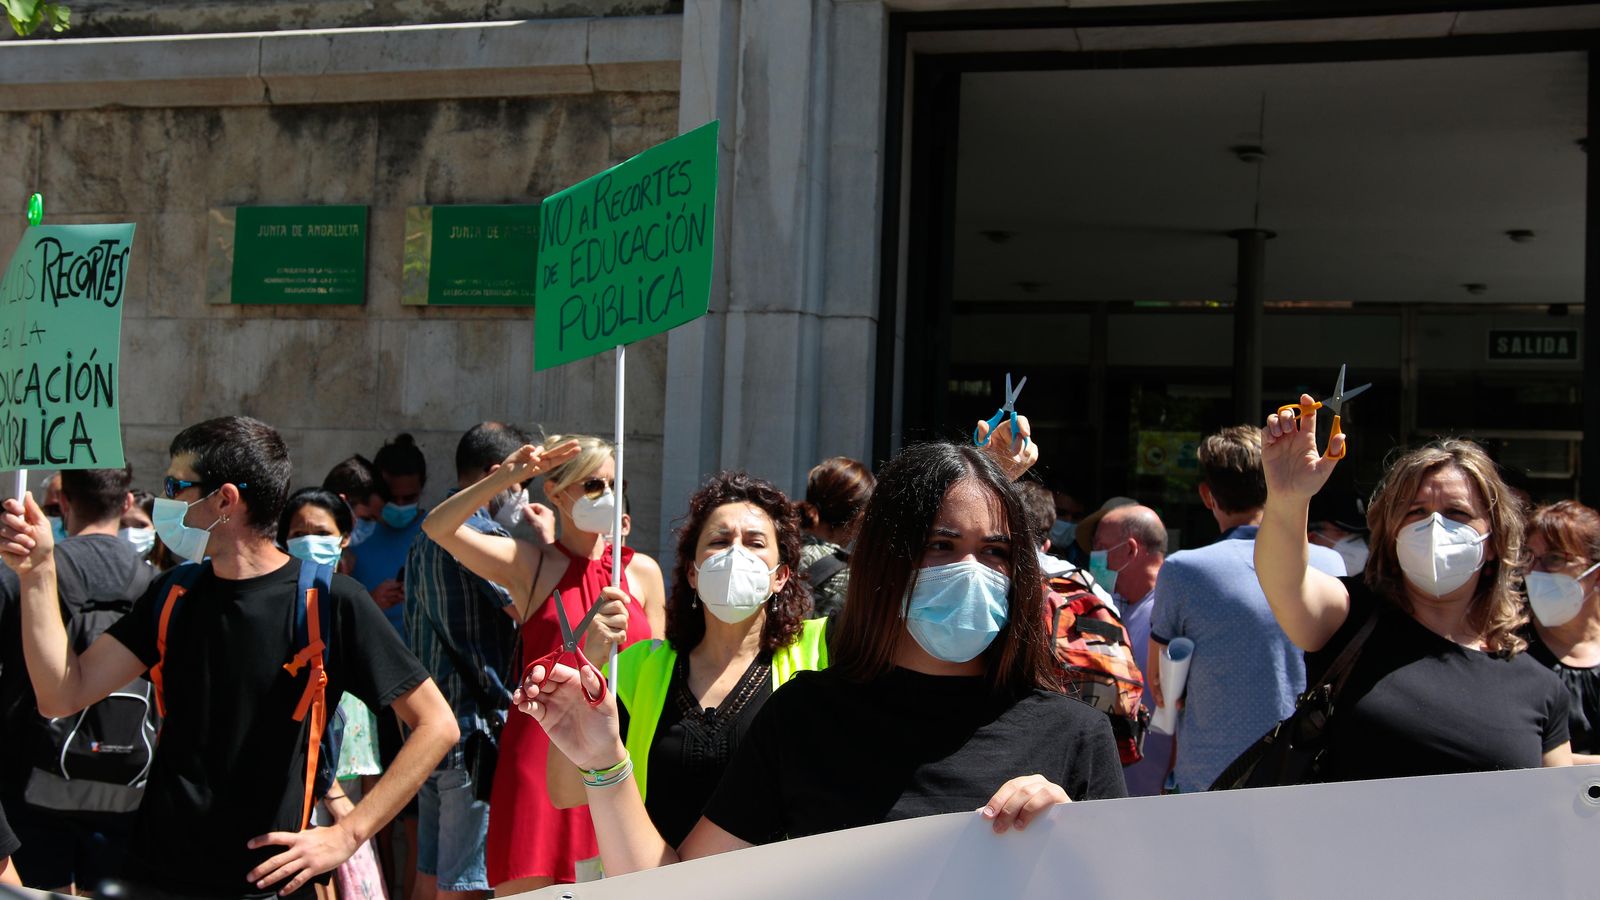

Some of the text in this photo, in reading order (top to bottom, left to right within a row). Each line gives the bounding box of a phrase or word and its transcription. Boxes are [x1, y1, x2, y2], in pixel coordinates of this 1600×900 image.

[542, 160, 692, 252] NO A RECORTES
[257, 224, 287, 237] JUNTA
[292, 224, 303, 237] DE
[487, 225, 499, 239] DE
[35, 237, 129, 308] RECORTES
[543, 262, 559, 289] DE
[1496, 336, 1569, 354] SALIDA
